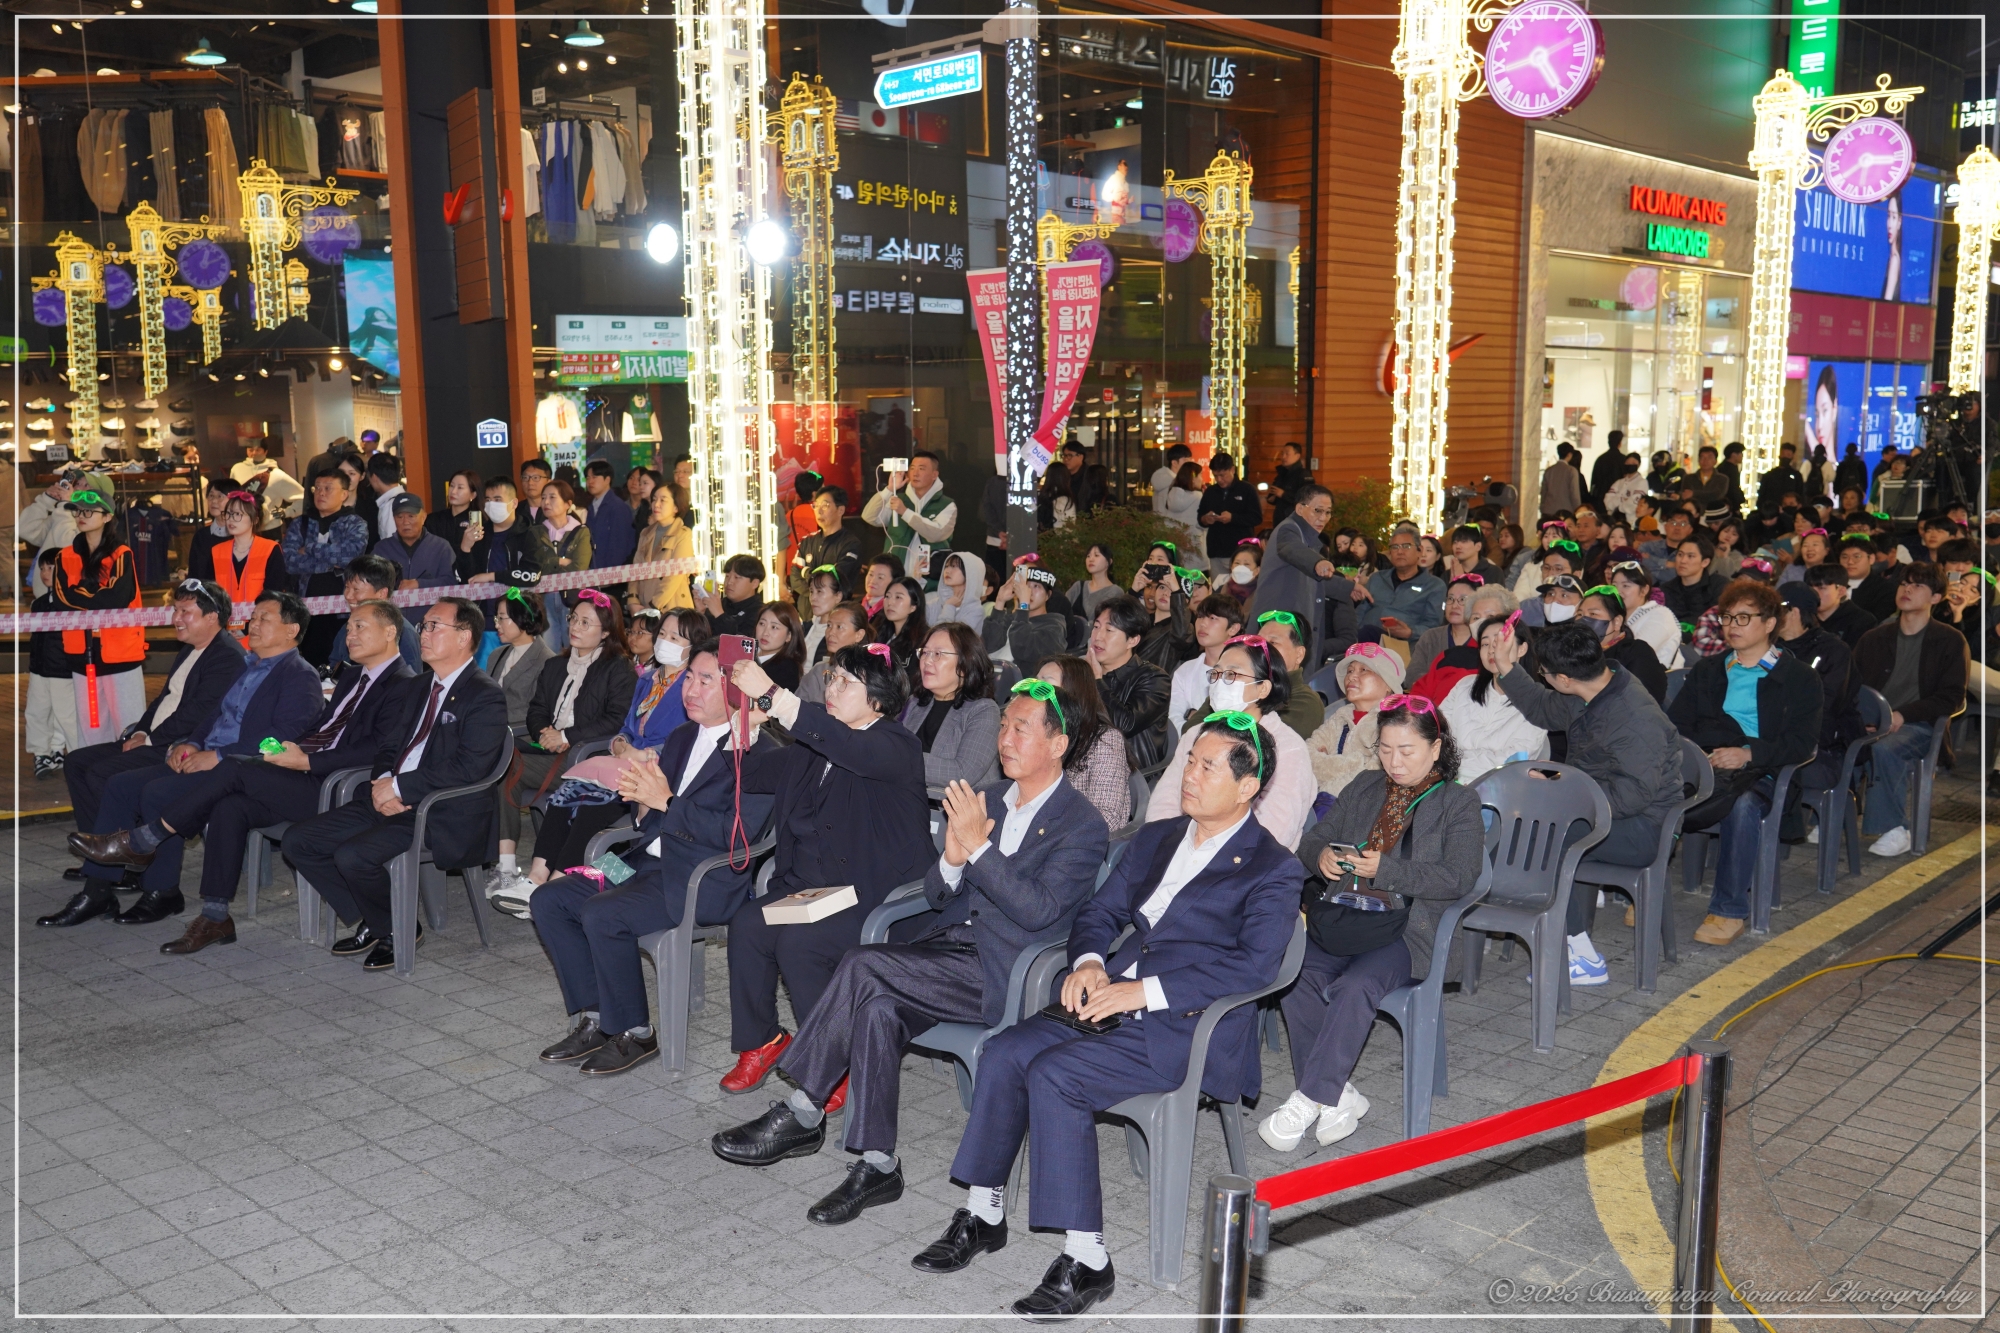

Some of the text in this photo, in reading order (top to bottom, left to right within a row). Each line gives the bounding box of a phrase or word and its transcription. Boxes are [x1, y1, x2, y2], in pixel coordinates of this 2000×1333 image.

[912, 57, 975, 82] 서면로68번길
[888, 77, 976, 103] Seomyeon-ro 68beon-gil
[1630, 184, 1728, 227] KUMKANG
[1803, 189, 1867, 238] SHURINK
[1647, 222, 1709, 258] LANDROVER
[1802, 237, 1864, 262] UNIVERSE
[483, 433, 503, 445] 10
[1189, 431, 1210, 443] SALE
[1032, 446, 1049, 465] busa
[990, 1186, 1003, 1208] NIKE
[1095, 1233, 1105, 1246] NI
